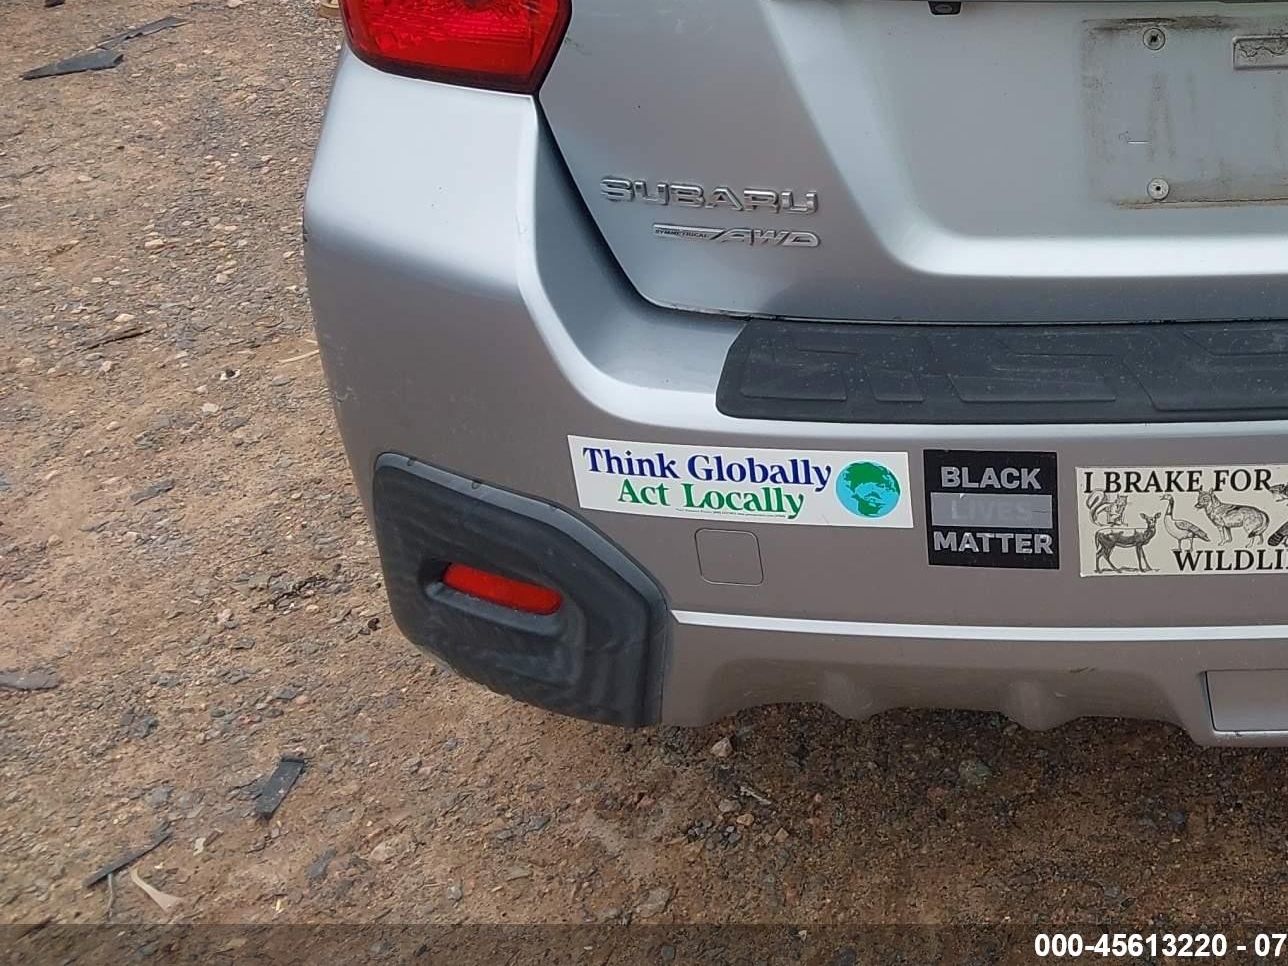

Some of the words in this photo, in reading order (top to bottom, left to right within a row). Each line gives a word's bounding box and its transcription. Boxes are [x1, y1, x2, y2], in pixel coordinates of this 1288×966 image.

[601, 176, 818, 215] SUBARU
[711, 227, 821, 247] AWD
[583, 447, 680, 479] Think
[687, 454, 832, 492] Globally
[941, 466, 1041, 489] BLACK
[1083, 471, 1094, 494] I
[1104, 470, 1204, 493] BRAKE
[1213, 468, 1272, 492] FOR
[618, 479, 670, 506] Act
[680, 483, 805, 519] Locally
[933, 531, 1053, 554] MATTER
